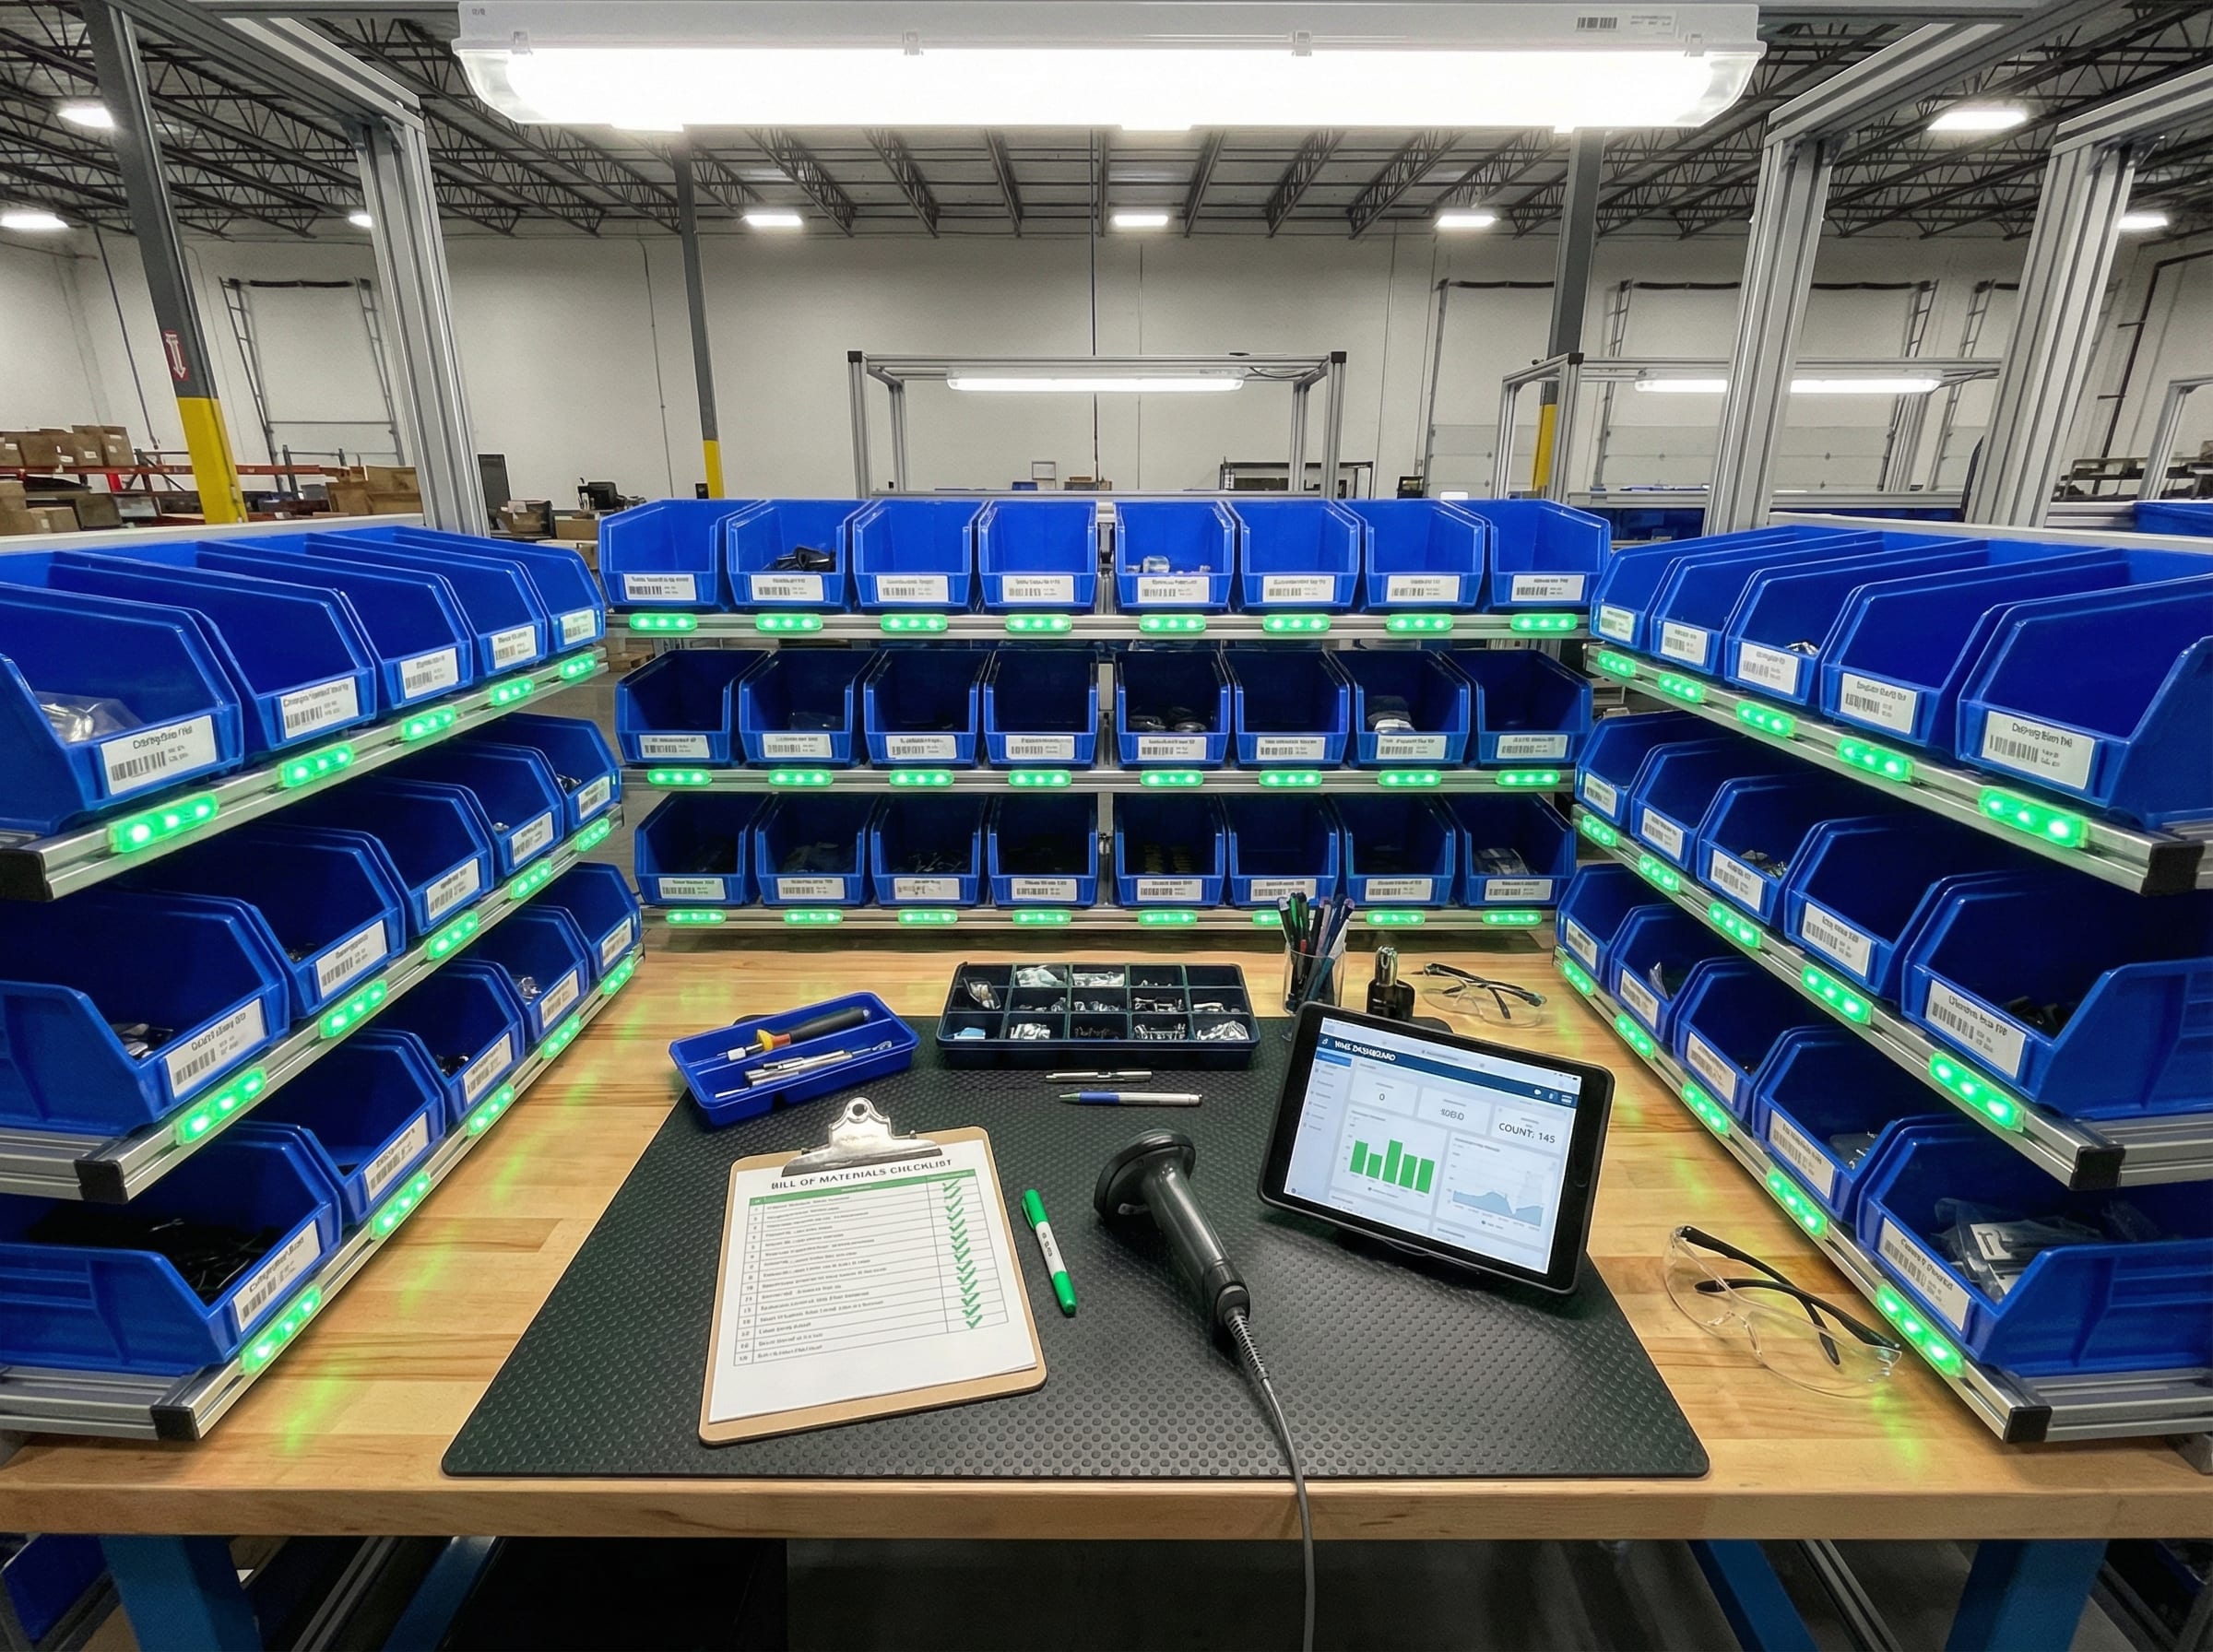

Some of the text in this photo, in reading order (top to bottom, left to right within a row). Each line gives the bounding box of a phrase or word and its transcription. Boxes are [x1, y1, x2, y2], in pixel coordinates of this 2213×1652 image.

[1498, 1122, 1535, 1139] COUNT:
[771, 1159, 953, 1190] BILL OF MATERIALS CHECKLIST
